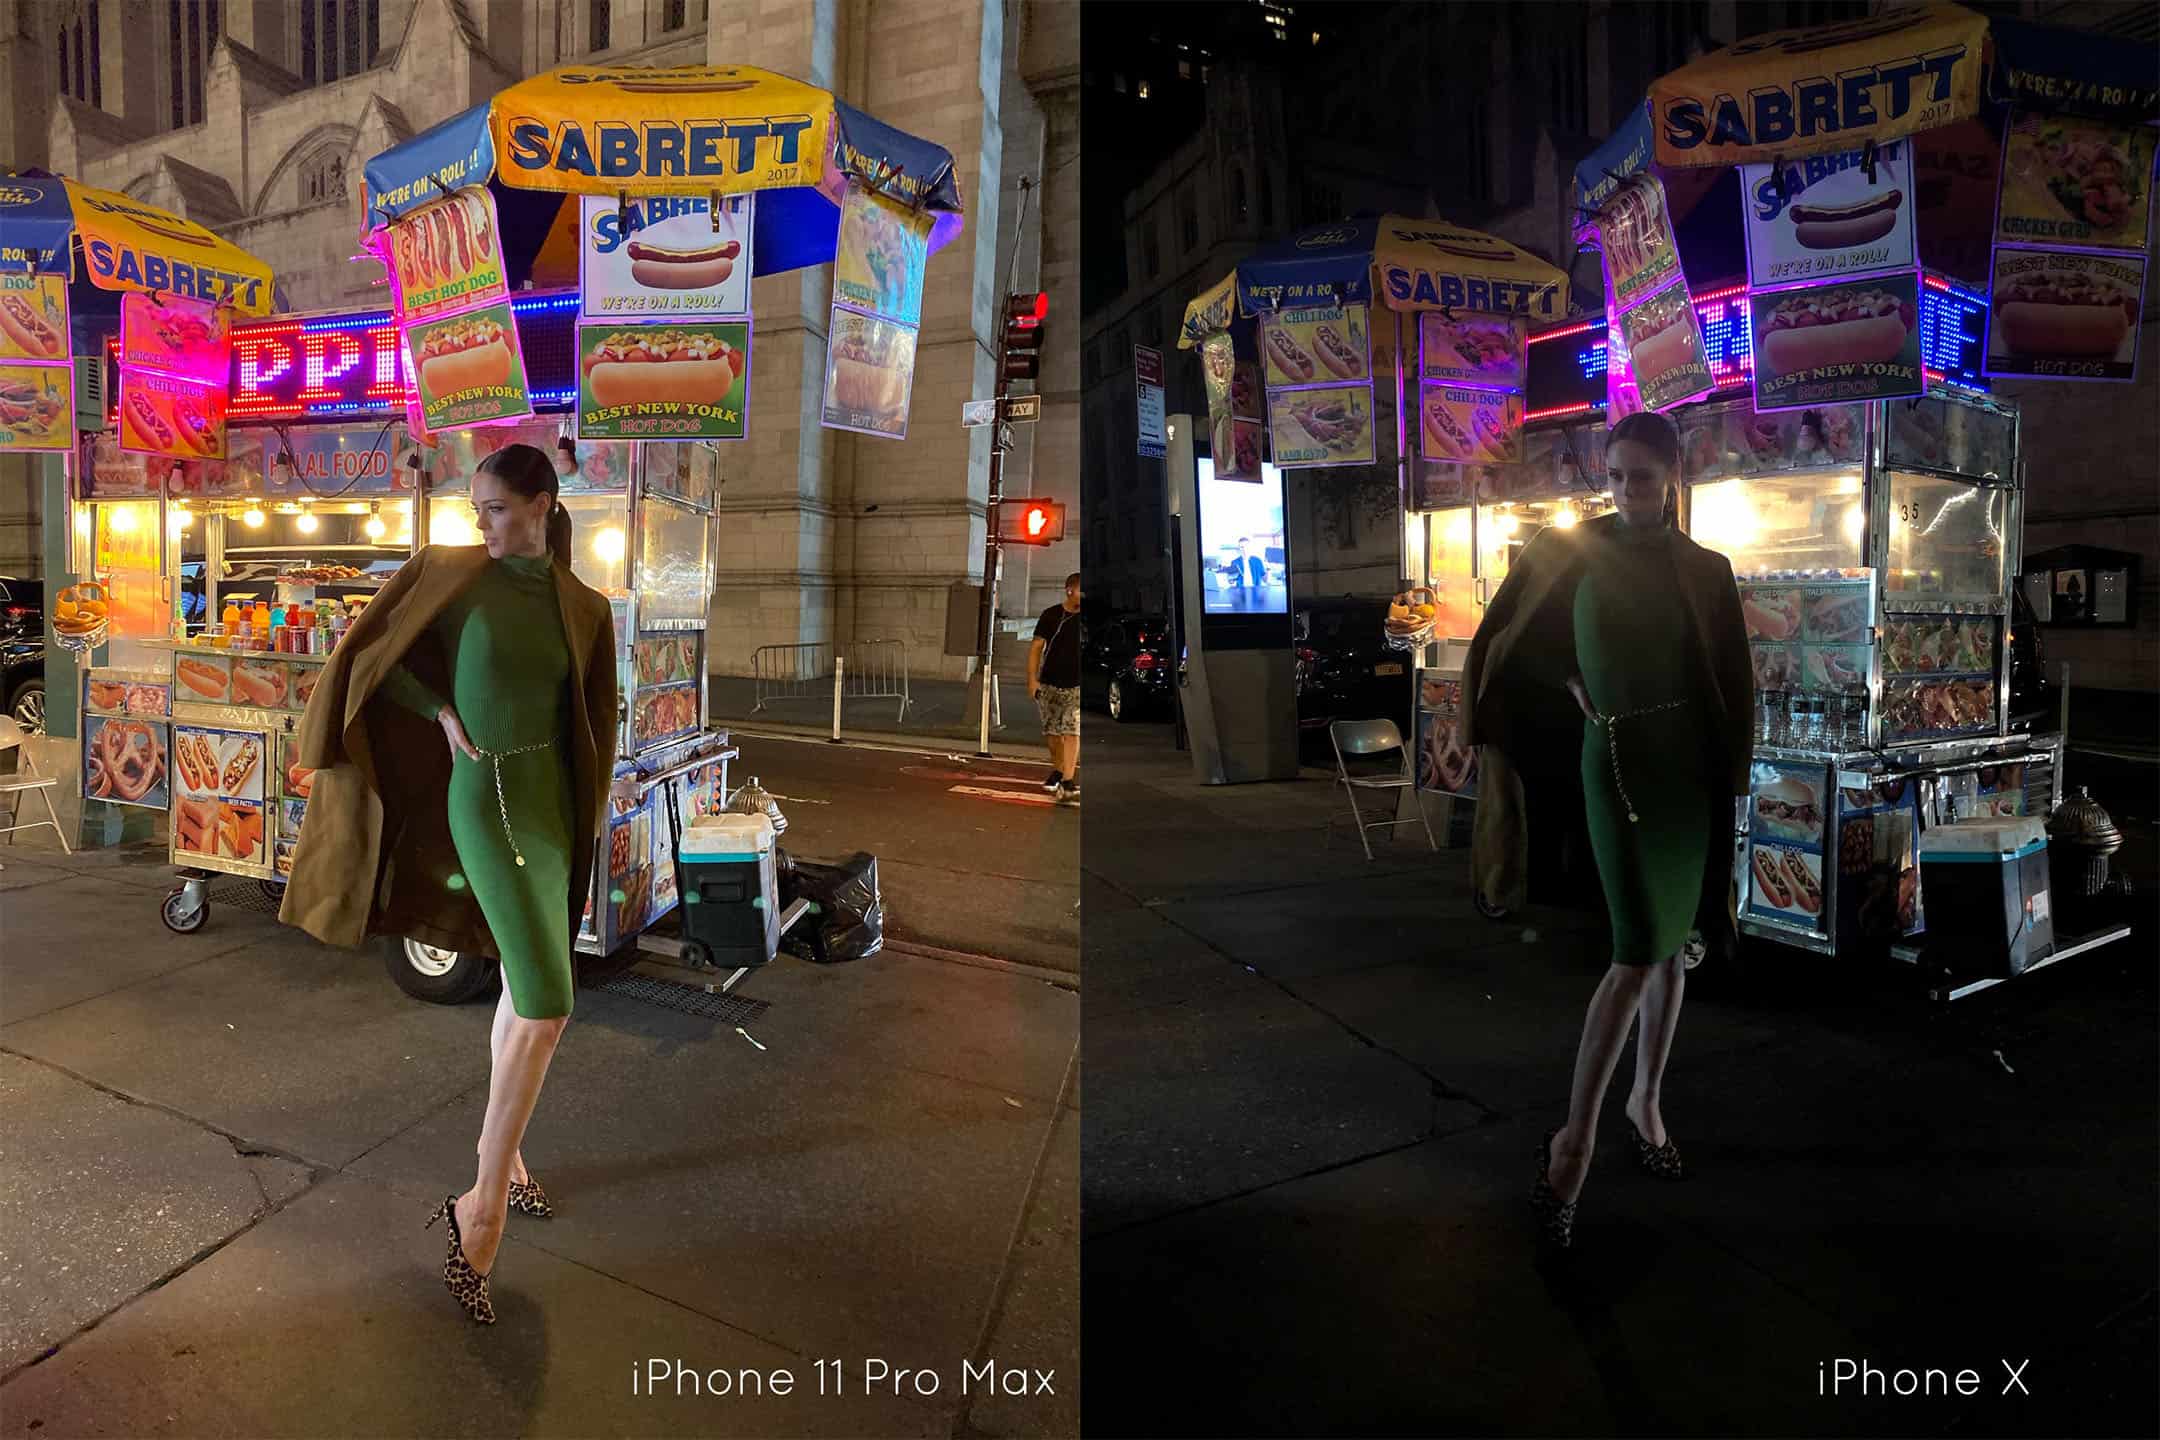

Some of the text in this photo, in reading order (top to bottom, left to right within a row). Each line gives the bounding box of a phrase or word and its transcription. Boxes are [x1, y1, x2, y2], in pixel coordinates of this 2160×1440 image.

[1664, 43, 1967, 148] SABRETT
[1919, 103, 1951, 122] 2017
[508, 115, 813, 178] SABRETT
[377, 184, 411, 207] WE'RE
[414, 176, 428, 197] ON
[440, 160, 466, 186] ROLL
[767, 167, 798, 181] 2017
[86, 233, 263, 307] SABRETT
[1769, 248, 1890, 278] WE'RE ON A ROLL!
[4, 277, 36, 291] DOG
[408, 288, 438, 308] BEST
[441, 279, 466, 298] HOT
[470, 271, 498, 290] DOG
[1288, 285, 1303, 297] ON
[1306, 285, 1315, 297] A
[1384, 264, 1560, 314] SABRETT
[601, 295, 725, 311] WE'RE ON A ROLL!
[1319, 310, 1345, 322] DOG
[1762, 361, 1916, 394] BEST NEW YORK
[2032, 359, 2066, 375] HOT
[426, 385, 523, 416] BEST NEW YORK
[585, 402, 739, 425] BEST NEW YORK
[620, 418, 657, 433] HOT
[660, 418, 702, 433] DOG
[333, 452, 388, 477] FOOD
